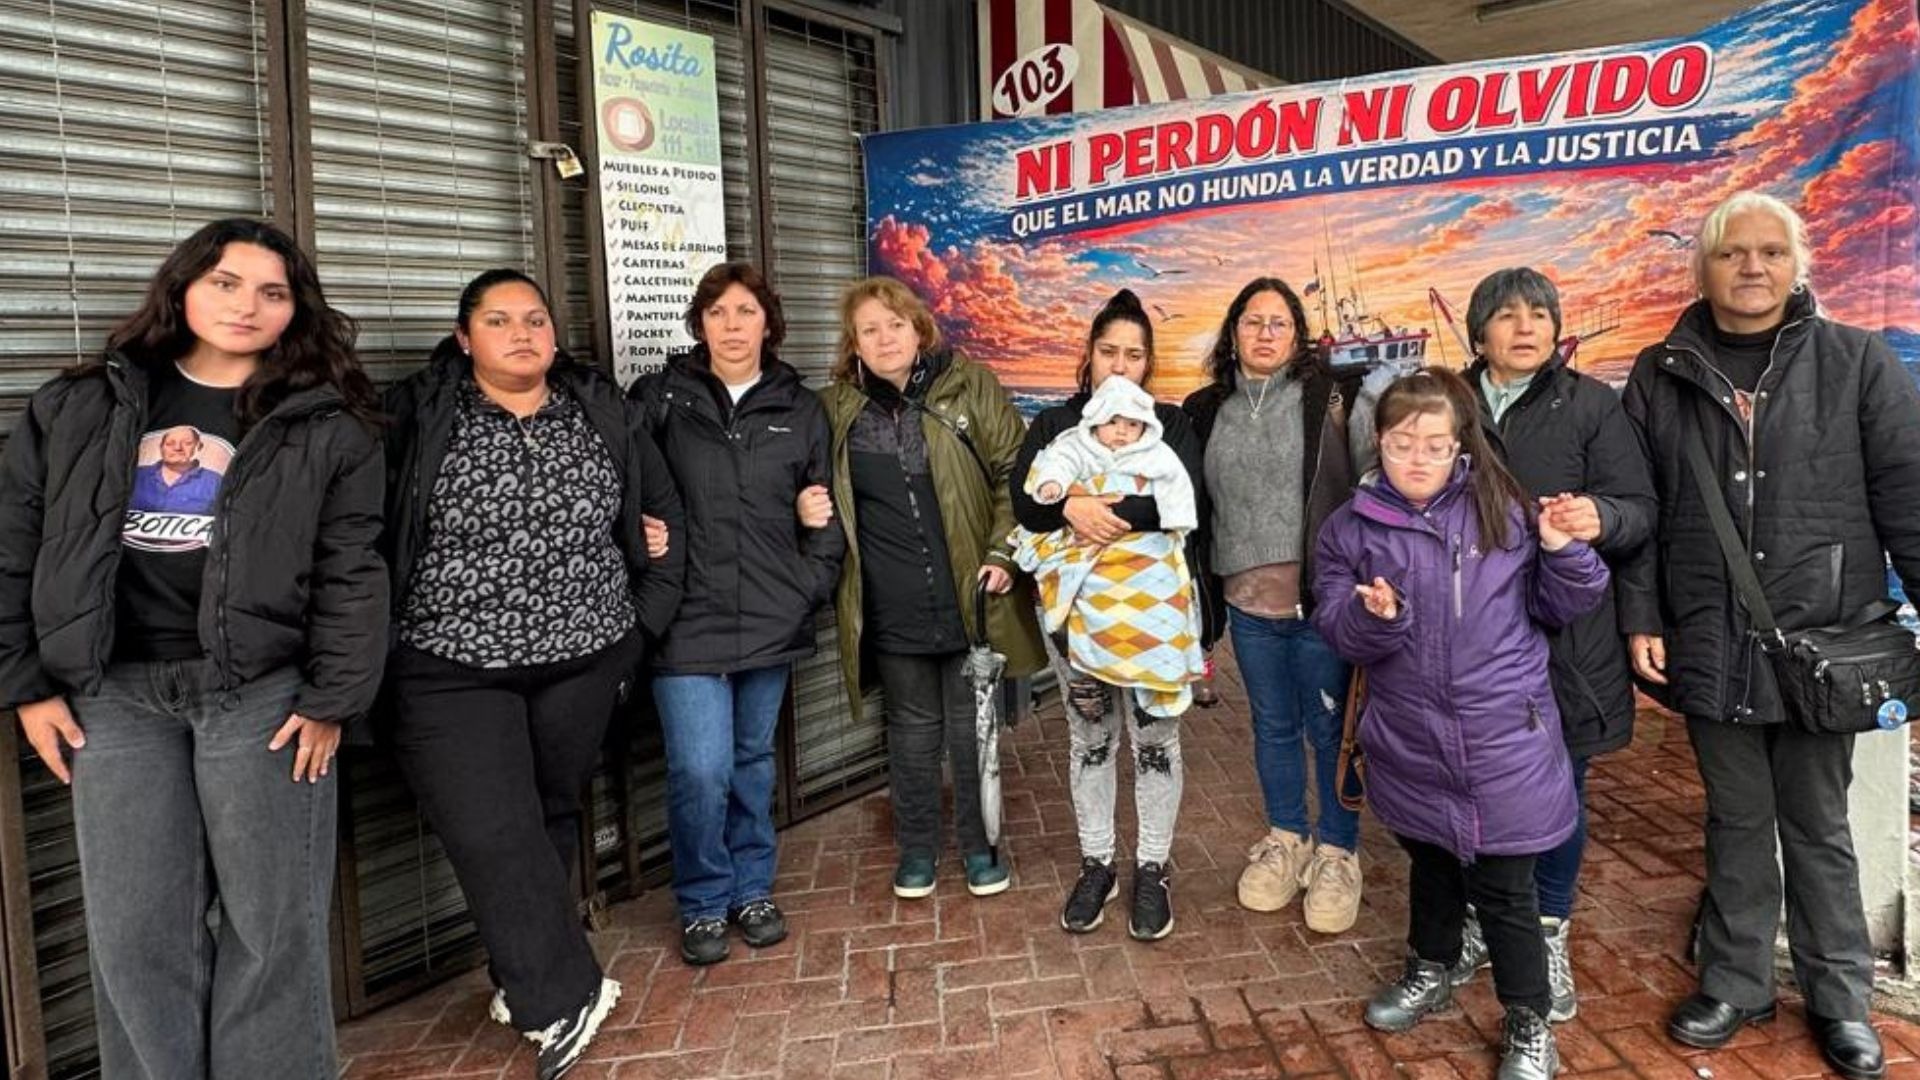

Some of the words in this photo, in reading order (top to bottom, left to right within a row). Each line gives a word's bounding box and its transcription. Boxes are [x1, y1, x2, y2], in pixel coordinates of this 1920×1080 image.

[605, 22, 703, 77] Rosita
[1001, 46, 1065, 112] 103
[1015, 142, 1073, 199] NI
[1088, 97, 1323, 184] PERDÓN
[1338, 84, 1415, 146] NI
[1427, 45, 1708, 133] OLVIDO
[603, 161, 659, 177] MUEBLES
[661, 167, 670, 177] A
[616, 180, 670, 195] SILLONES
[1012, 207, 1056, 236] QUE
[1062, 202, 1089, 224] EL
[1096, 194, 1151, 219] MAR
[1158, 183, 1195, 206] NO
[1203, 169, 1297, 203] HUNDA
[1304, 171, 1333, 188] LA
[1340, 153, 1462, 185] VERDAD
[1470, 148, 1485, 170] Y
[1496, 144, 1531, 166] LA
[1539, 125, 1702, 164] JUSTICIA
[618, 200, 685, 216] CLEOPATRA
[621, 240, 660, 252] MESAS
[662, 241, 676, 252] DE
[679, 242, 724, 255] ARRIMO
[623, 257, 685, 270] CARTERAS
[624, 275, 695, 288] CALCETINES
[625, 293, 688, 304] MANTELES
[628, 328, 673, 340] JOCKEY
[629, 345, 664, 357] ROPA
[123, 511, 214, 537] BOTICA
